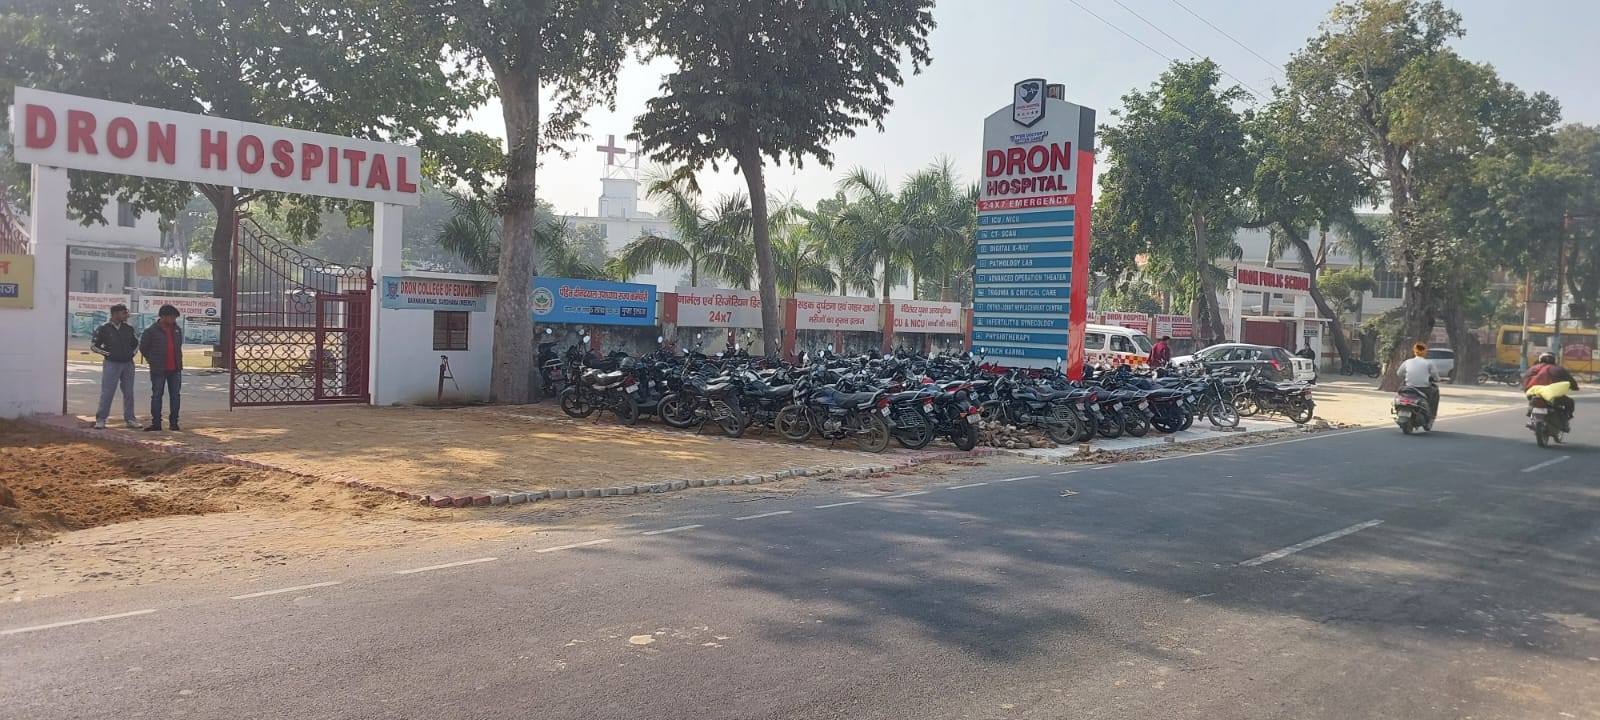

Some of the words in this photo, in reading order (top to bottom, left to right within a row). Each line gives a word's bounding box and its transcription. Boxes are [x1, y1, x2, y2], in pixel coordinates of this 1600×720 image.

[25, 104, 176, 165] DRON
[200, 129, 417, 194] HOSPITAL
[986, 142, 1071, 178] DRON
[986, 175, 1068, 196] HOSPITAL
[983, 199, 1006, 210] 24X7
[1009, 196, 1069, 208] EMERGENCY
[400, 281, 416, 294] DRON
[418, 282, 445, 295] COLLEGE
[445, 284, 452, 296] OF
[1260, 271, 1283, 288] PUBLIC
[1285, 274, 1310, 291] SCHOOL
[709, 311, 732, 323] 24x7
[905, 319, 909, 327] &
[911, 319, 925, 328] NICU
